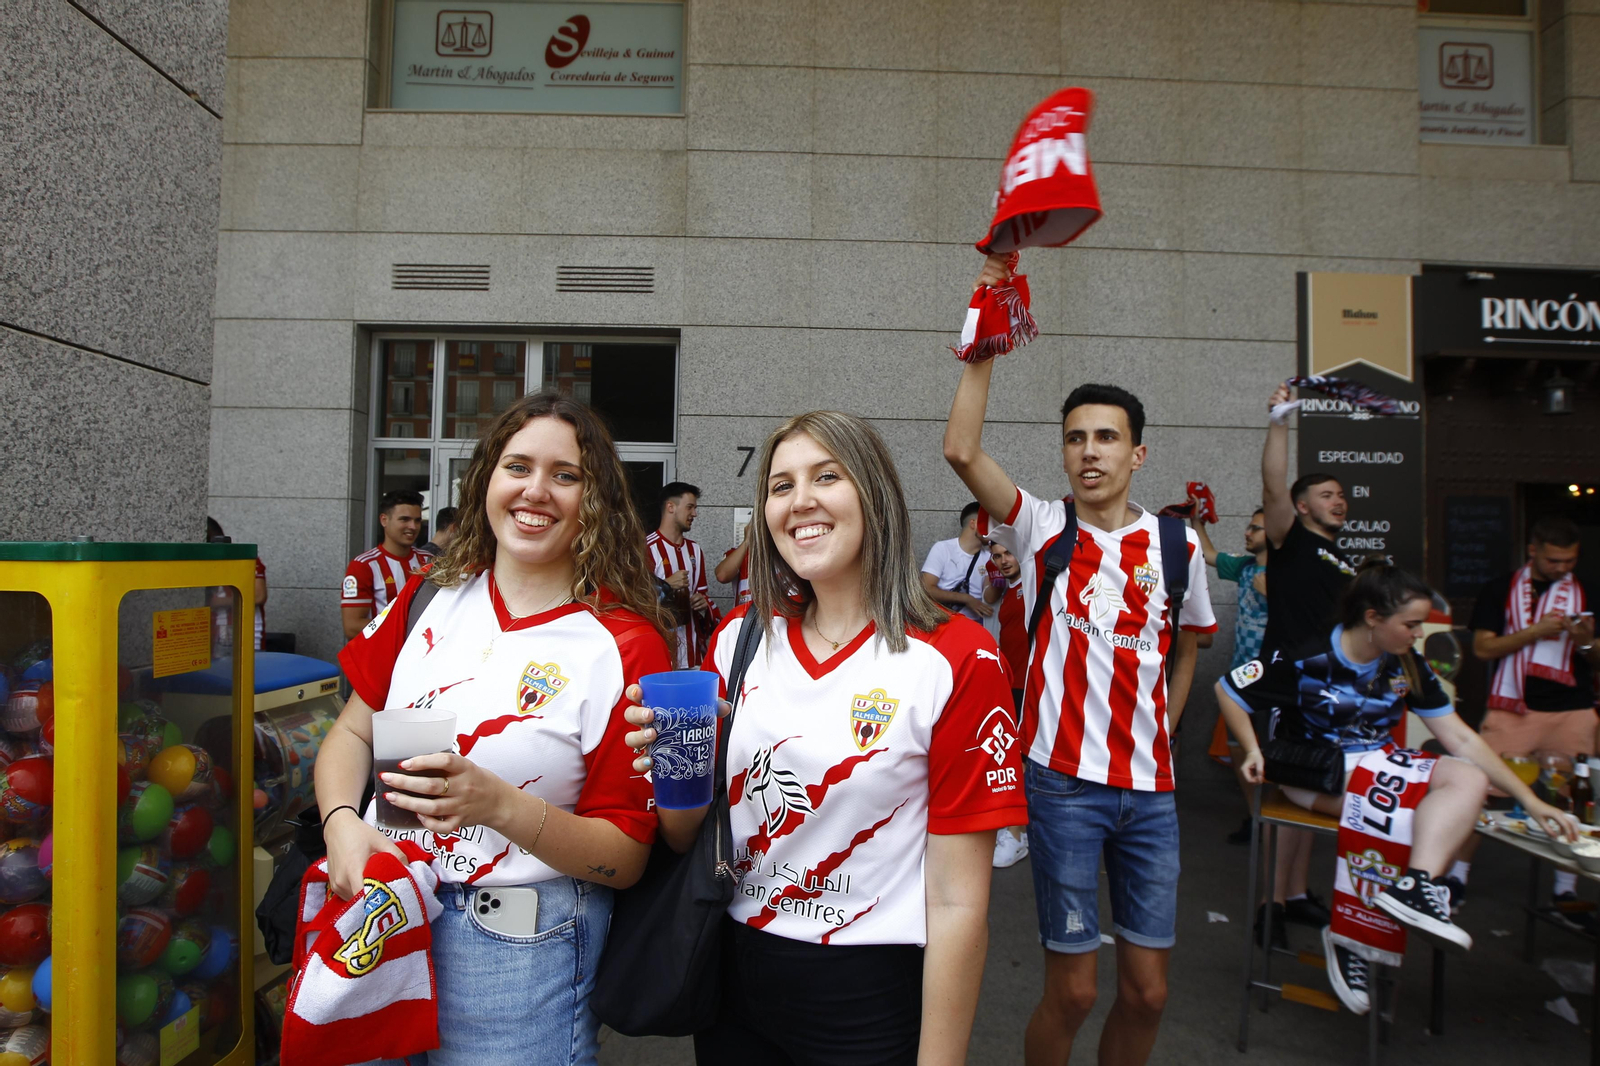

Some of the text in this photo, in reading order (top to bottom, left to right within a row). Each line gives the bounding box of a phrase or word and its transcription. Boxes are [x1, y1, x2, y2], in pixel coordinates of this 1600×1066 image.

[623, 48, 632, 58] &
[636, 48, 675, 59] Guinot
[457, 65, 471, 80] &
[472, 65, 536, 85] Abogados
[614, 72, 627, 82] de
[630, 71, 675, 84] Seguros
[1469, 101, 1526, 118] Abogados
[737, 446, 756, 478] 7
[1318, 450, 1404, 464] ESPECIALIDAD
[1352, 485, 1370, 498] EN
[1341, 520, 1391, 533] ACALAO
[1336, 537, 1386, 550] CARNES
[1103, 629, 1151, 652] Centres
[530, 667, 562, 686] U D
[523, 677, 556, 697] ALMERIA
[857, 700, 892, 711] U D
[854, 711, 888, 722] ALMERIA
[682, 724, 716, 746] LARIOS
[986, 767, 1017, 787] PDR
[767, 887, 846, 926] Centres
